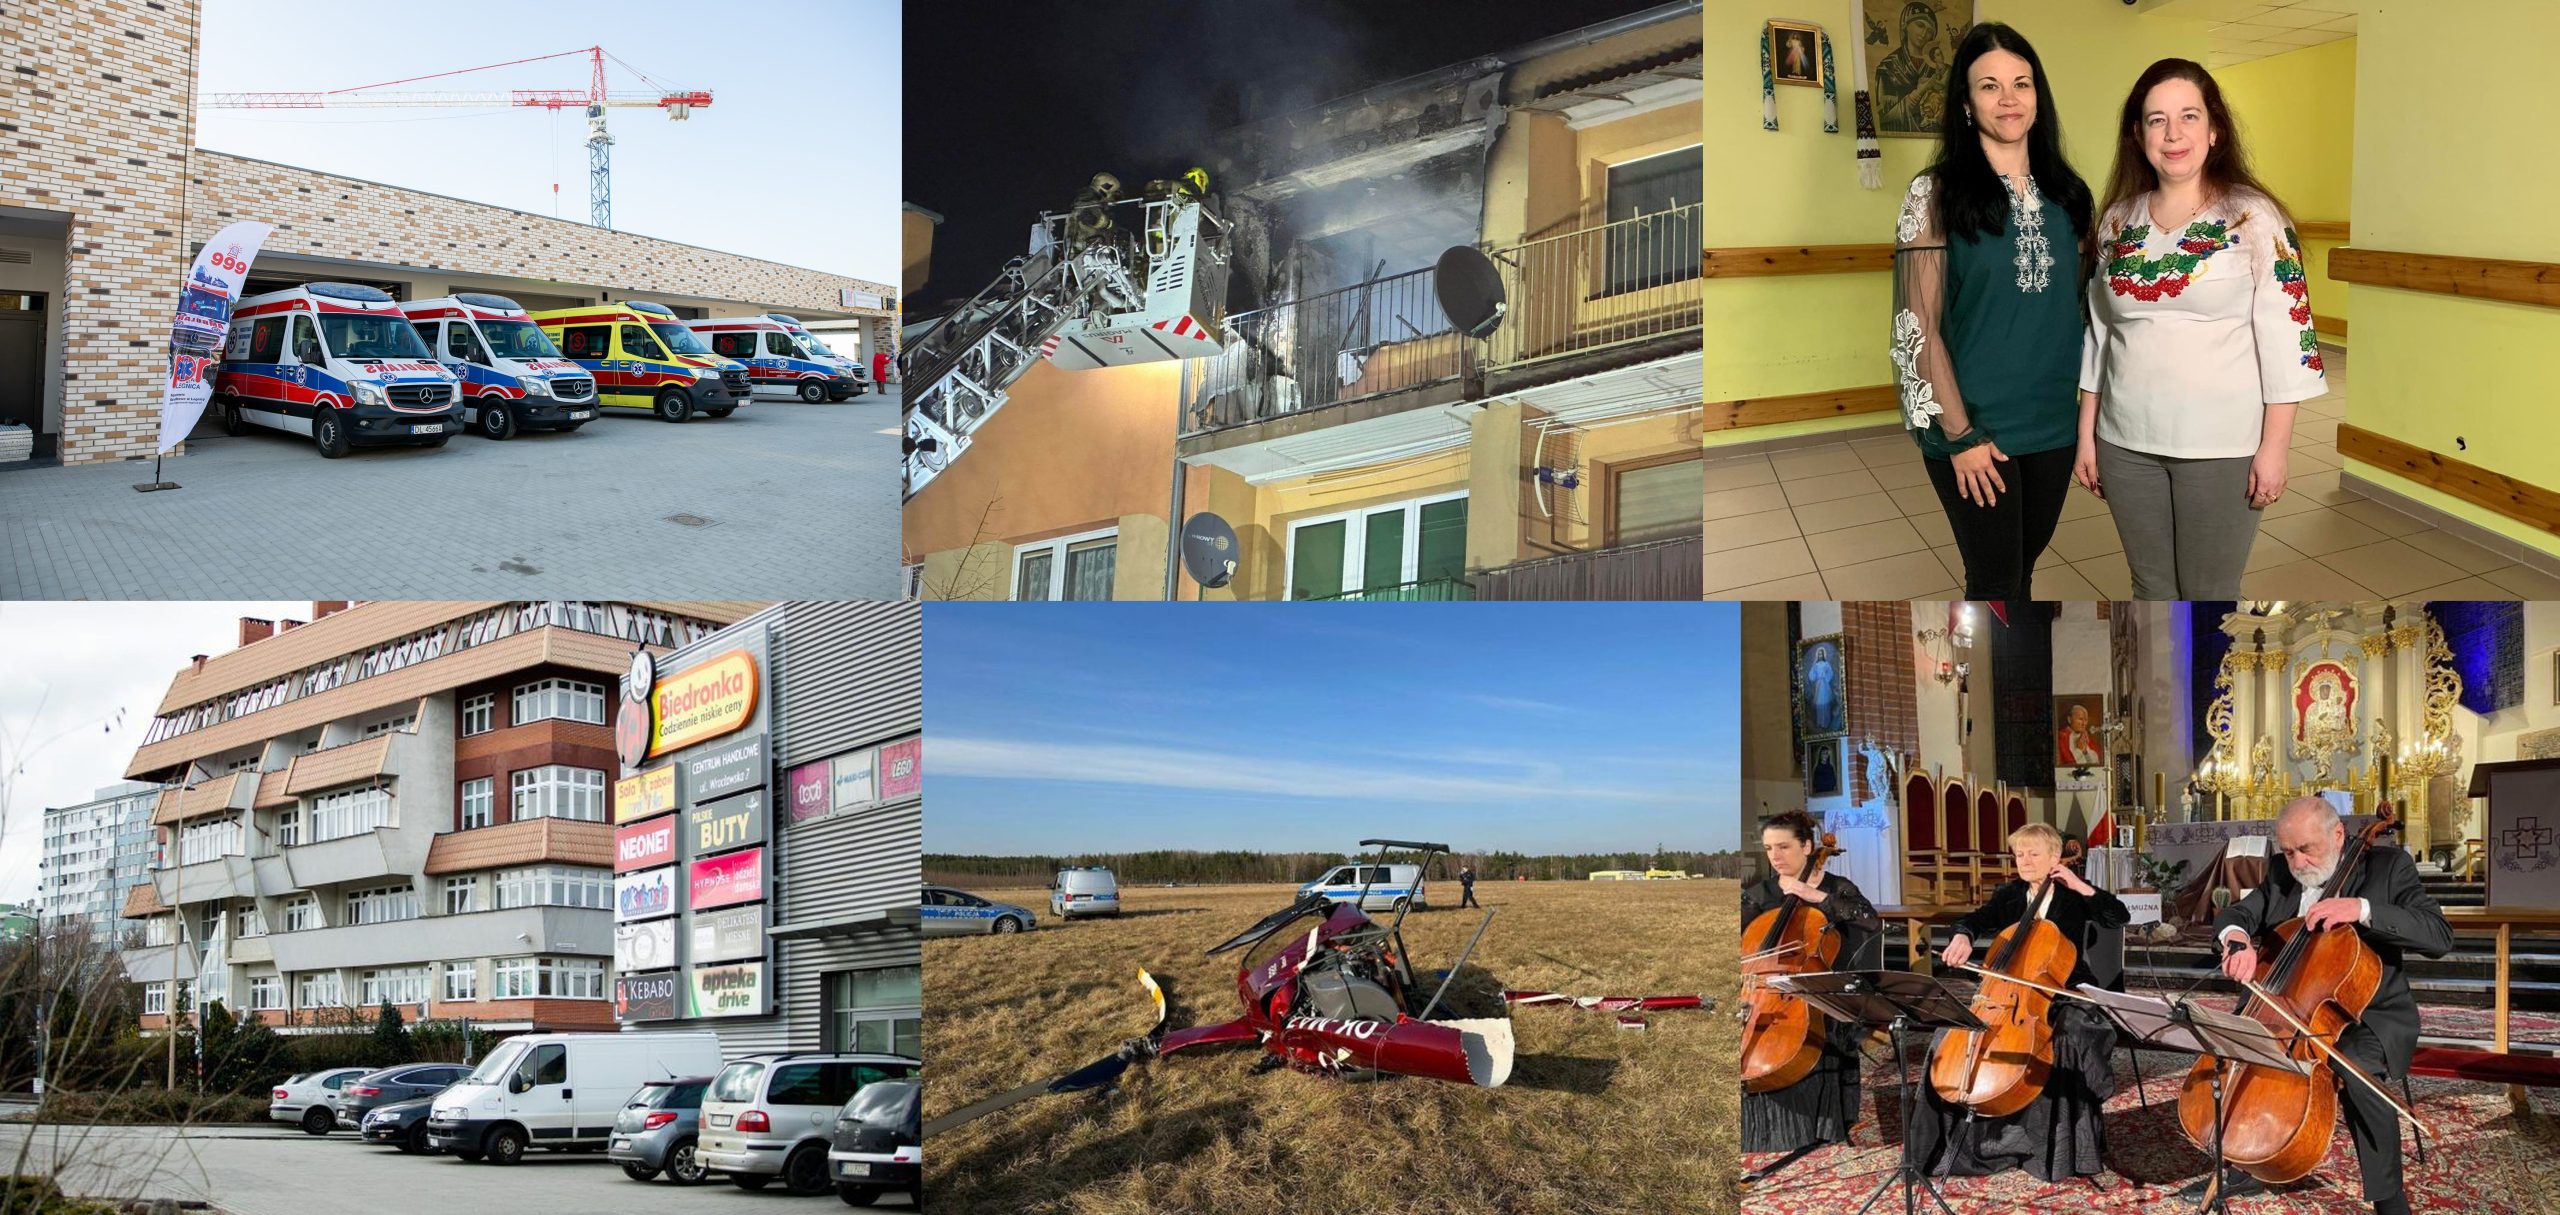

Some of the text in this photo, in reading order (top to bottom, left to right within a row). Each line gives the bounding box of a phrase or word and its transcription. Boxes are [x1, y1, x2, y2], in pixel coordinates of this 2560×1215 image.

[211, 252, 247, 275] 999
[659, 670, 743, 721] Biedronka
[658, 700, 743, 737] Codziennie niskie ceny
[692, 743, 759, 775] CENTRUM HANDLOWE
[892, 757, 913, 778] LEGO
[619, 782, 636, 799] Sala
[700, 781, 708, 793] ul.
[745, 767, 751, 780] 7
[692, 808, 713, 825] POLSKIE
[700, 811, 750, 849] BUTY
[620, 827, 670, 861] NEONET
[717, 911, 759, 929] DELIKATESY
[702, 967, 756, 995] apteka
[718, 991, 750, 1008] drive
